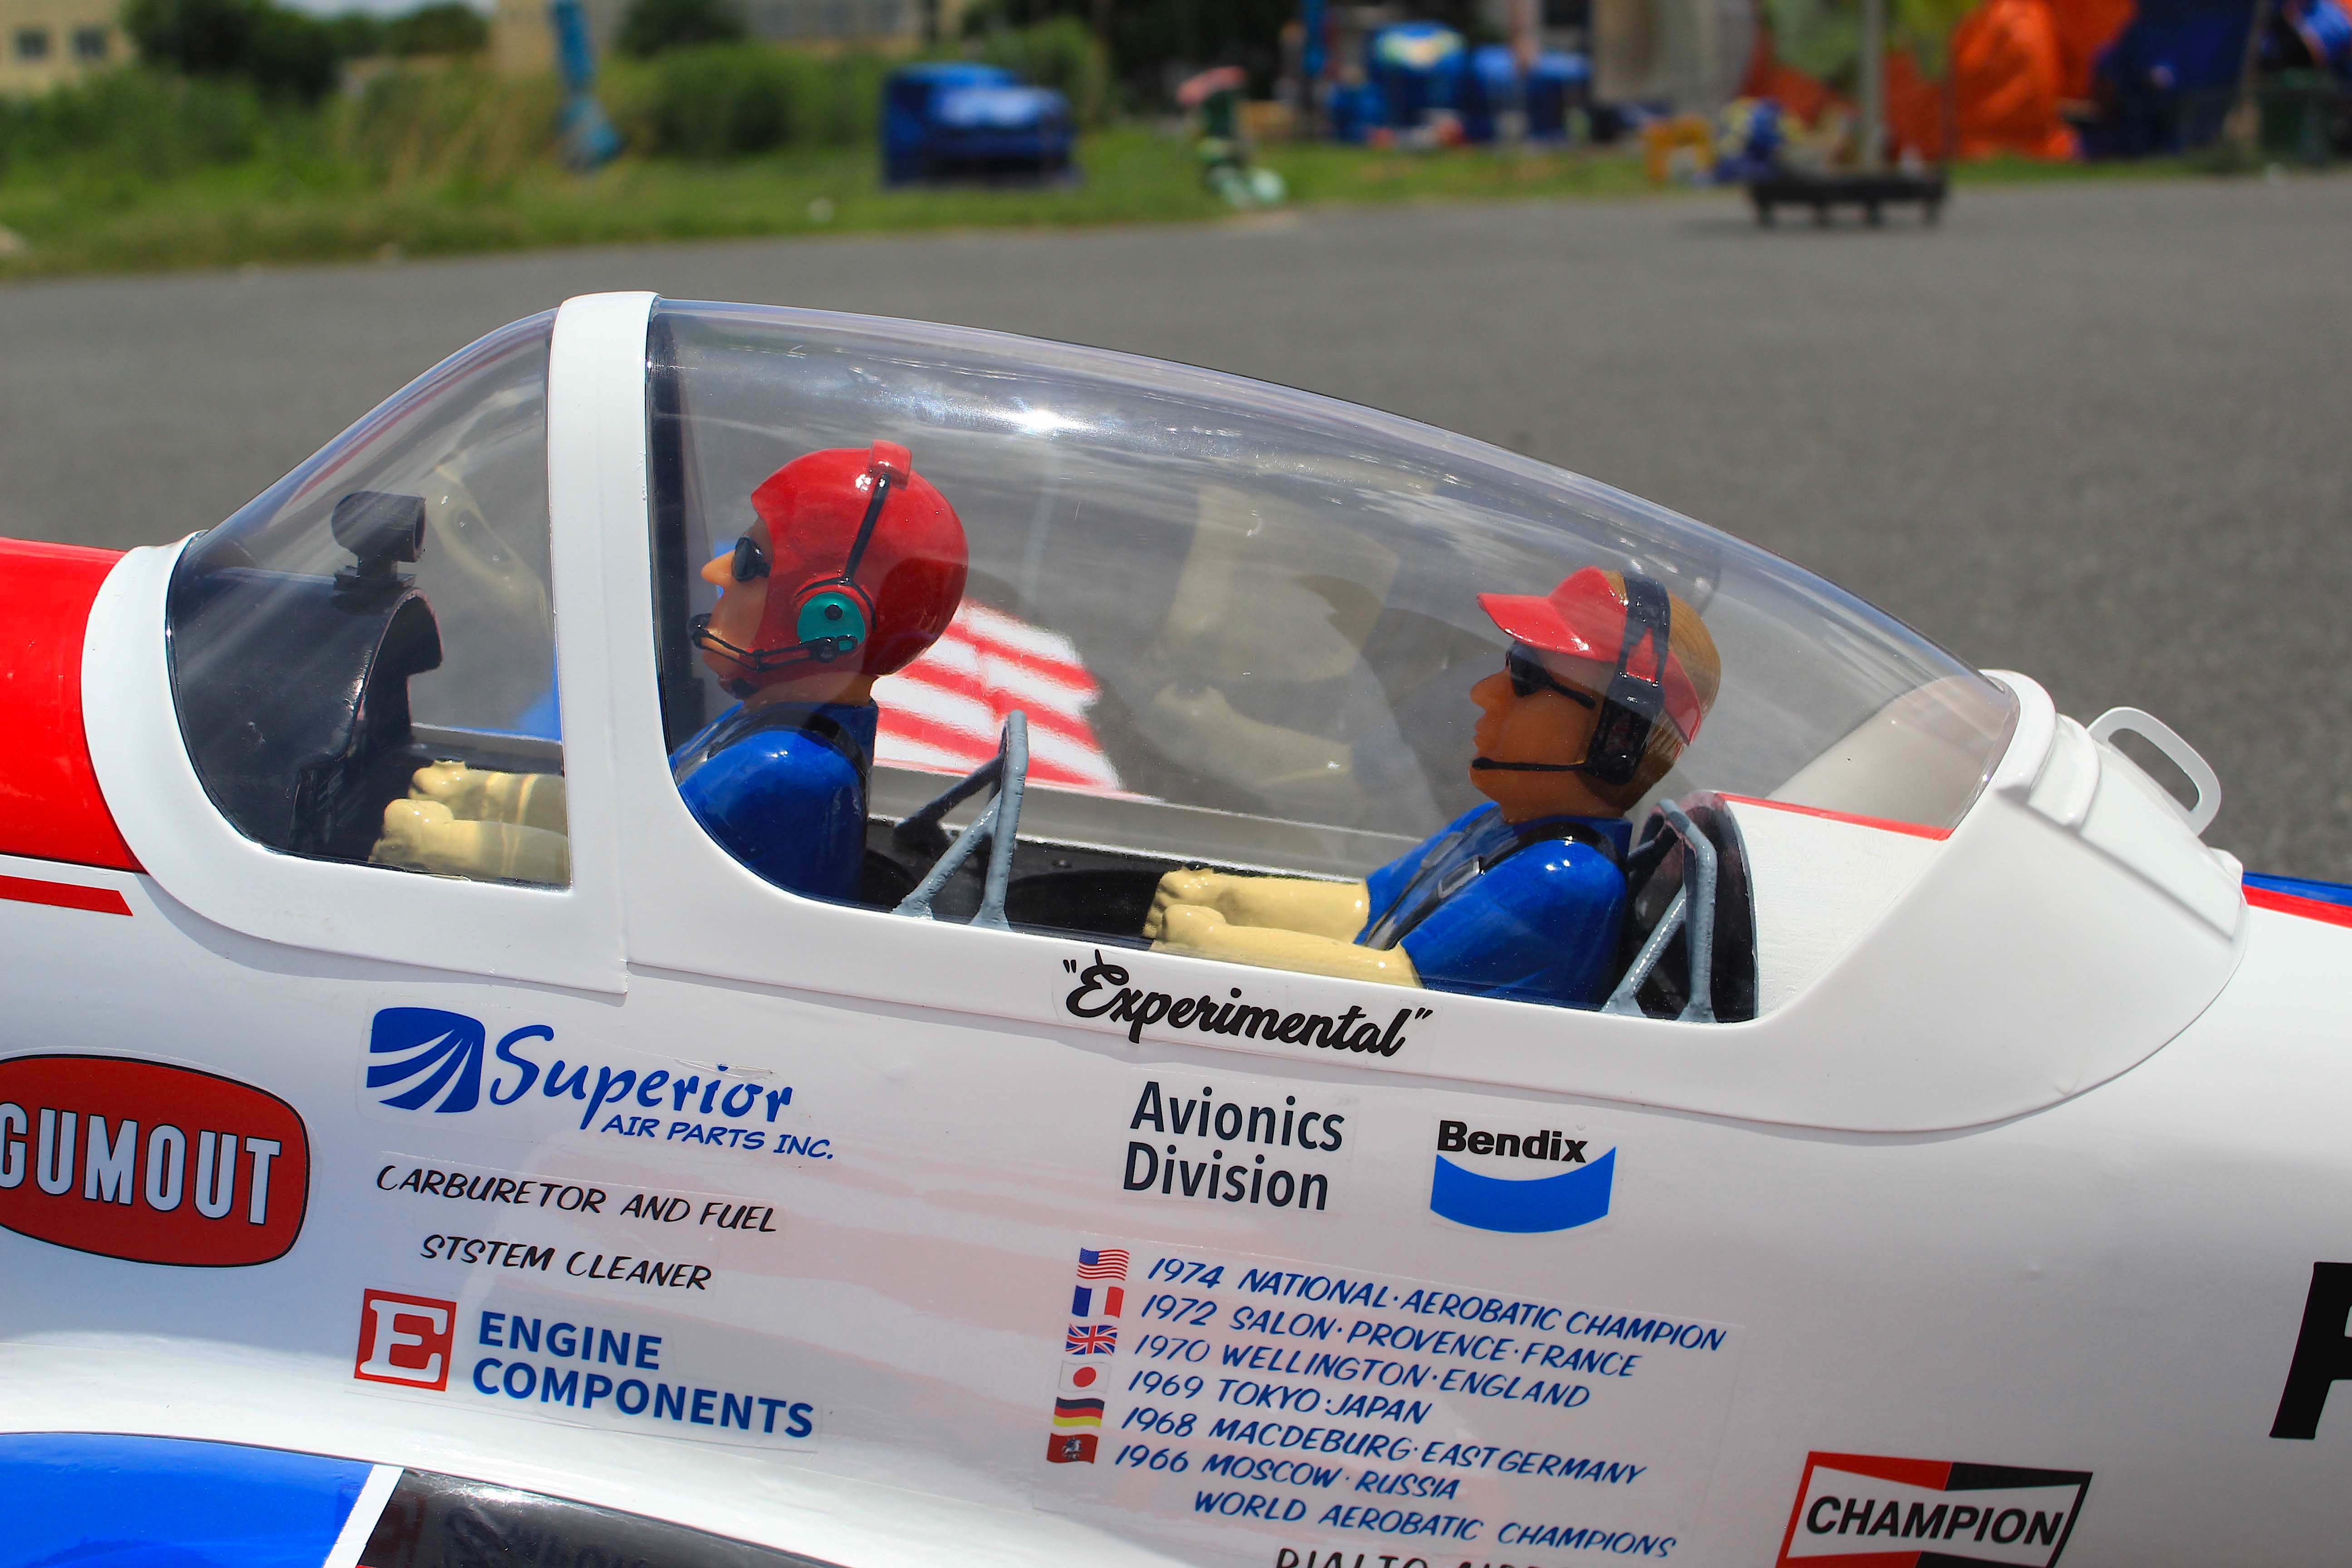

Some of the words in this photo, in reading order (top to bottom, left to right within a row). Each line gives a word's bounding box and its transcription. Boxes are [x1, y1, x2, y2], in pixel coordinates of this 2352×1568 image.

[490, 1025, 793, 1130] Superior
[602, 1115, 660, 1137] AIR
[667, 1122, 765, 1150] PARTS
[774, 1135, 833, 1159] INC.
[1130, 1082, 1345, 1152] Avionics
[1437, 1120, 1588, 1163] Bendix
[0, 1102, 281, 1225] GUMOUT
[1123, 1142, 1328, 1210] Division
[377, 1165, 607, 1213] CARBURETOR
[621, 1195, 690, 1223] AND
[700, 1202, 776, 1232] FUEL
[420, 1234, 555, 1271] STSTEM
[566, 1251, 711, 1290] CLEANER
[1141, 1294, 1217, 1326] 1972
[1148, 1258, 1225, 1288] 1974
[1566, 1311, 1726, 1351] CHAMPION
[359, 1299, 447, 1382] E
[479, 1311, 661, 1370] ENGINE
[1135, 1335, 1210, 1362] 1970
[473, 1358, 814, 1438] COMPONENTS
[1128, 1370, 1203, 1398] 1969
[1122, 1407, 1197, 1437] 1968
[1115, 1445, 1188, 1473] 1966
[1194, 1491, 1306, 1521] WORLD
[1318, 1505, 1483, 1540] AEROBATIC
[1498, 1523, 1676, 1558] CHAMPIONS
[1806, 1496, 2063, 1546] CHAMPION
